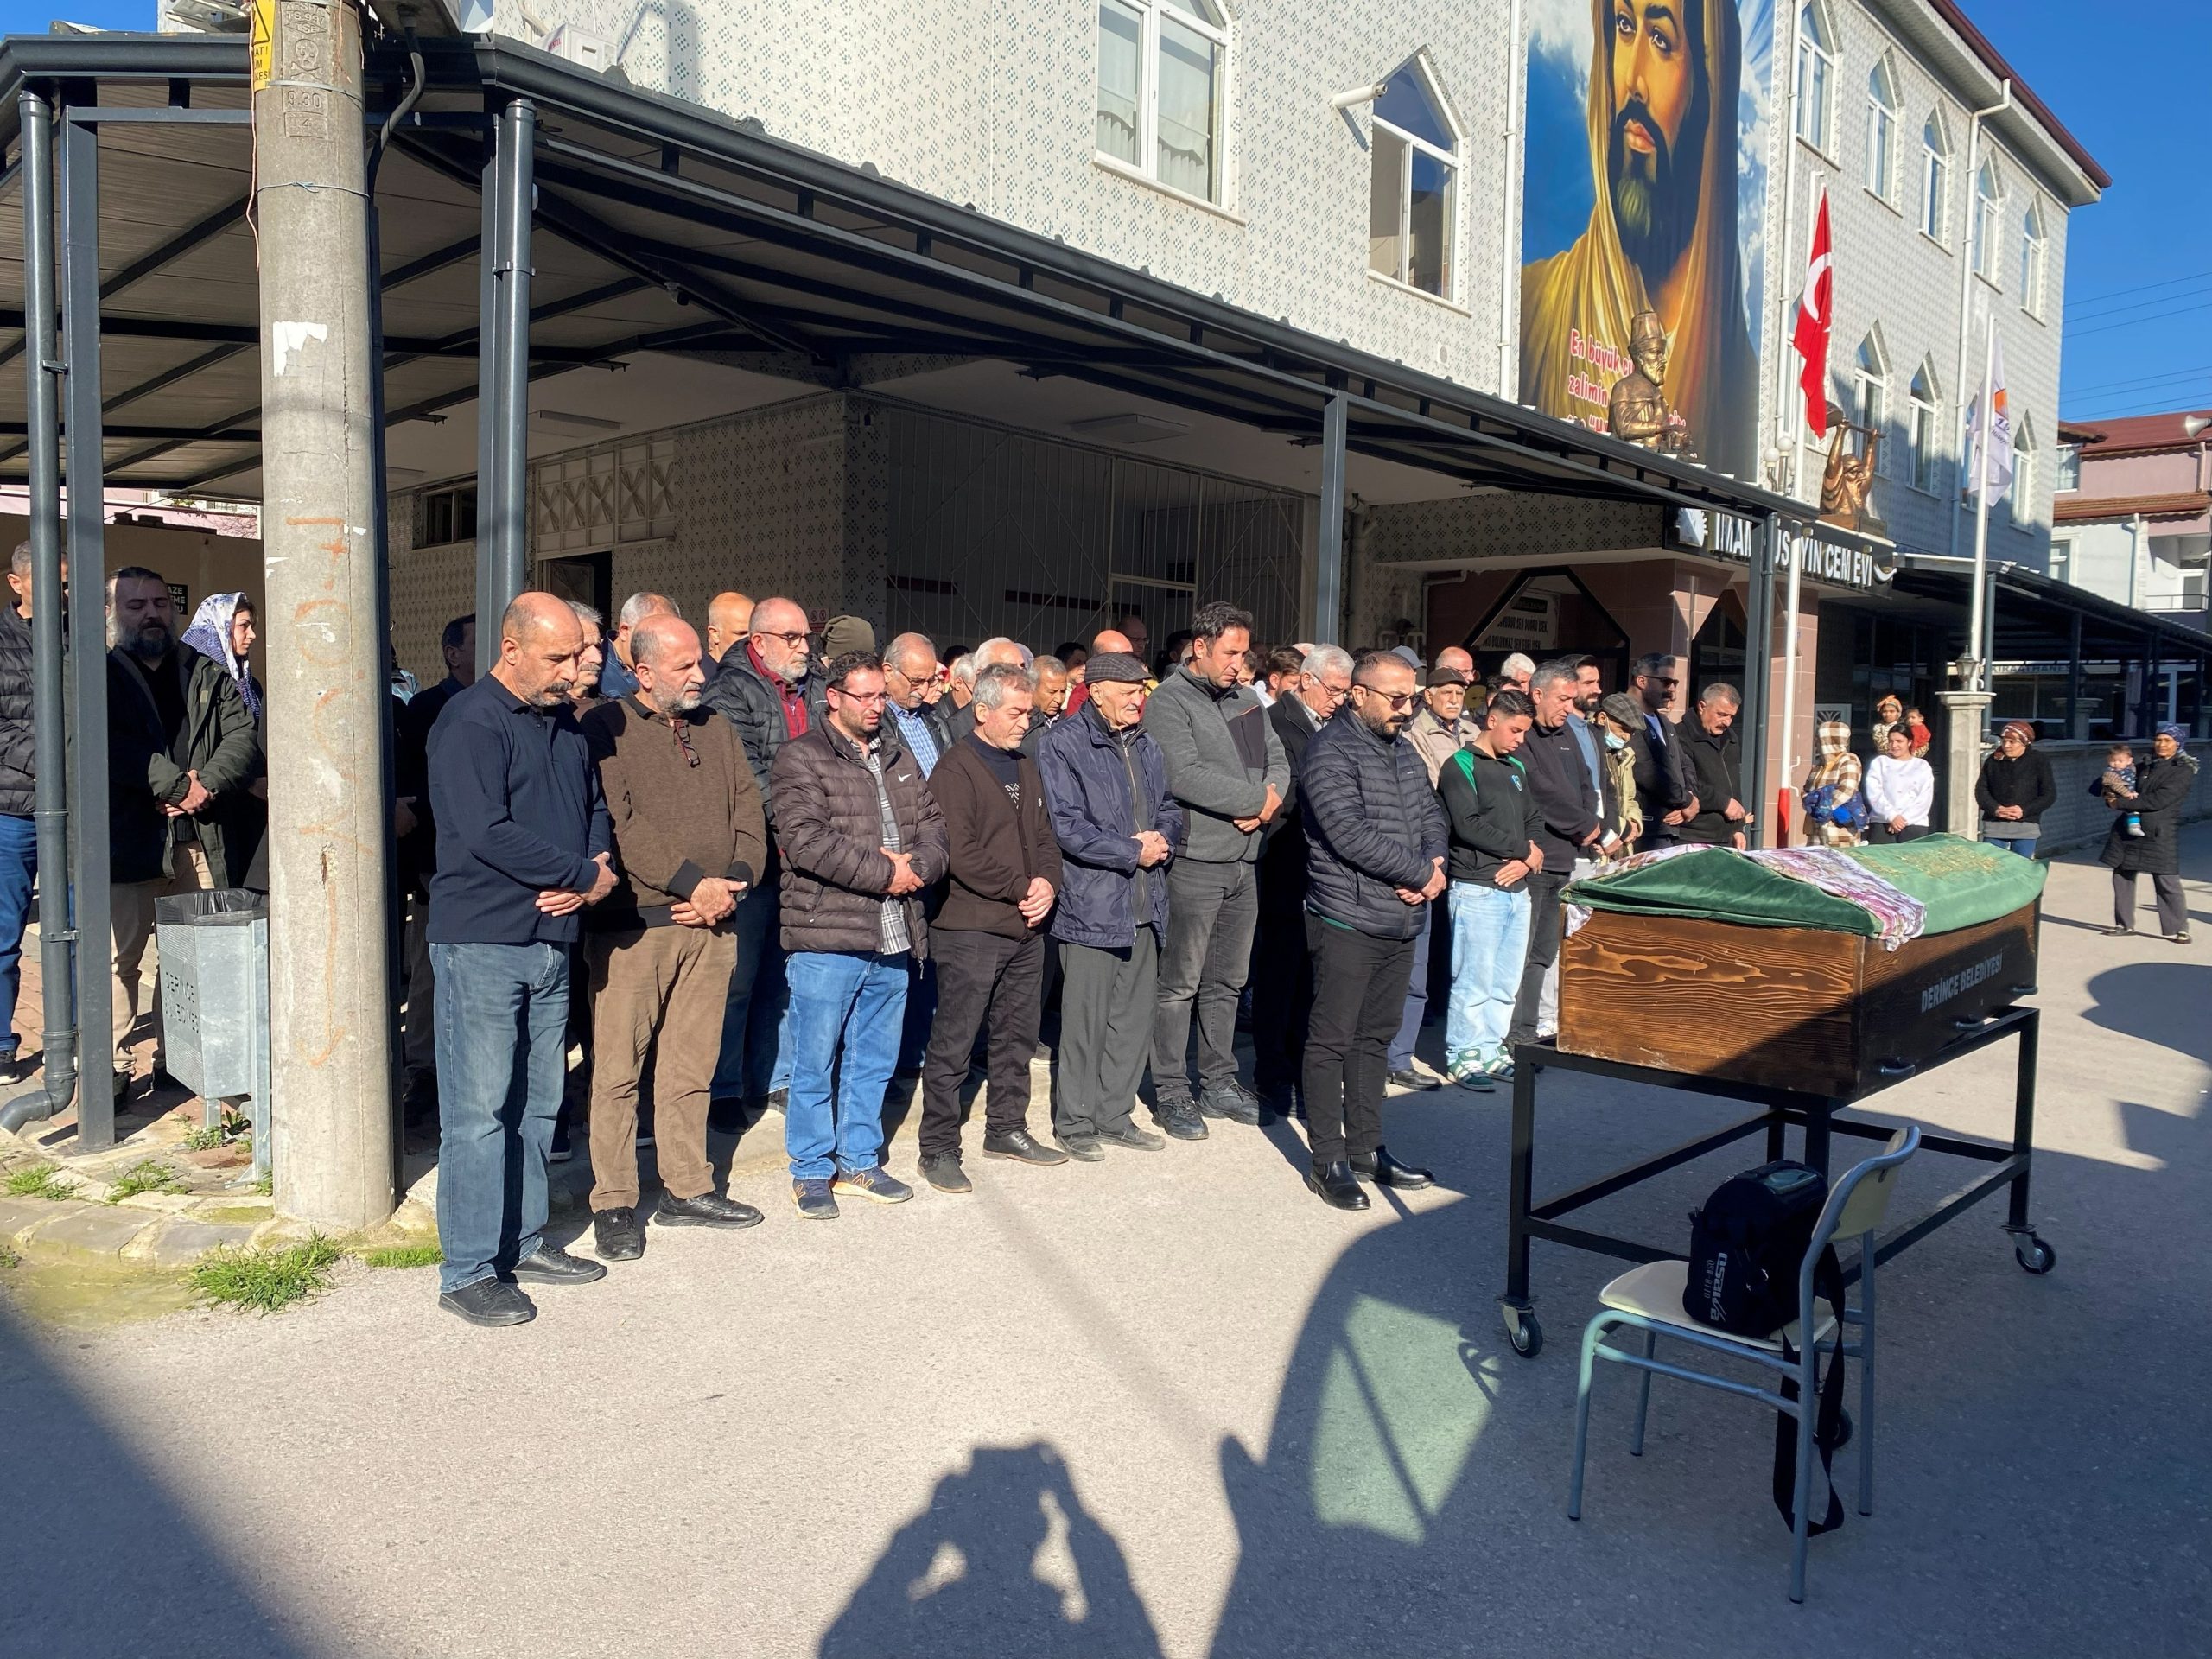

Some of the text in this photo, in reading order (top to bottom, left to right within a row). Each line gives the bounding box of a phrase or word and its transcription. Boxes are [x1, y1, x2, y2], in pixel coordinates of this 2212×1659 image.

[1571, 327, 1586, 359] En
[1588, 334, 1621, 374] büyük
[1568, 371, 1608, 409] zalimin
[1825, 543, 1852, 582] CEM
[1853, 545, 1873, 587] EVİ
[1921, 949, 2003, 1014] DERİNCE BELEDİYESİ
